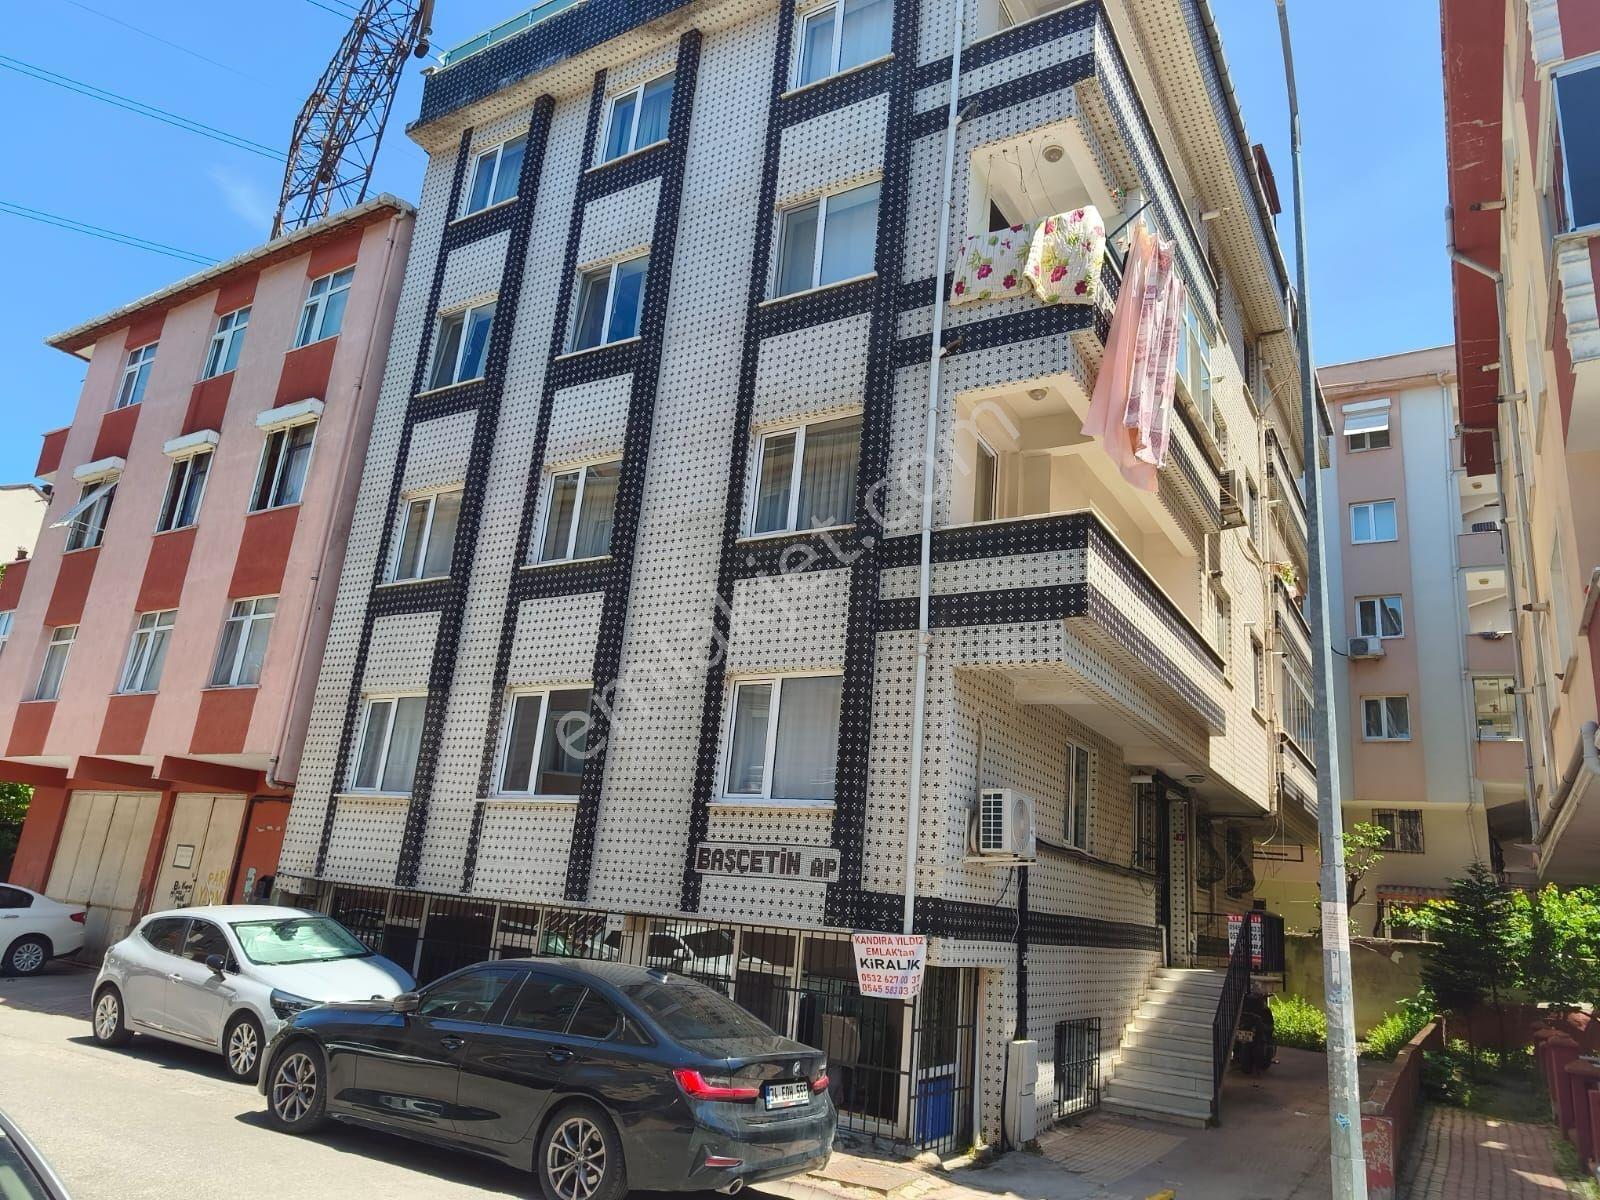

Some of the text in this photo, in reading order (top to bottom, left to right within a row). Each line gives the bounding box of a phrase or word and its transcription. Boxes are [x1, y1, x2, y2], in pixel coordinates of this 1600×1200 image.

[696, 847, 837, 878] BAŞÇETİN AP
[854, 936, 924, 946] KANDIRA YILDIZ
[866, 947, 915, 957] EMLAK'tan
[861, 973, 882, 983] 0532
[884, 975, 899, 984] 627
[862, 984, 883, 993] 0545
[898, 986, 909, 996] 03
[770, 1087, 779, 1101] 34
